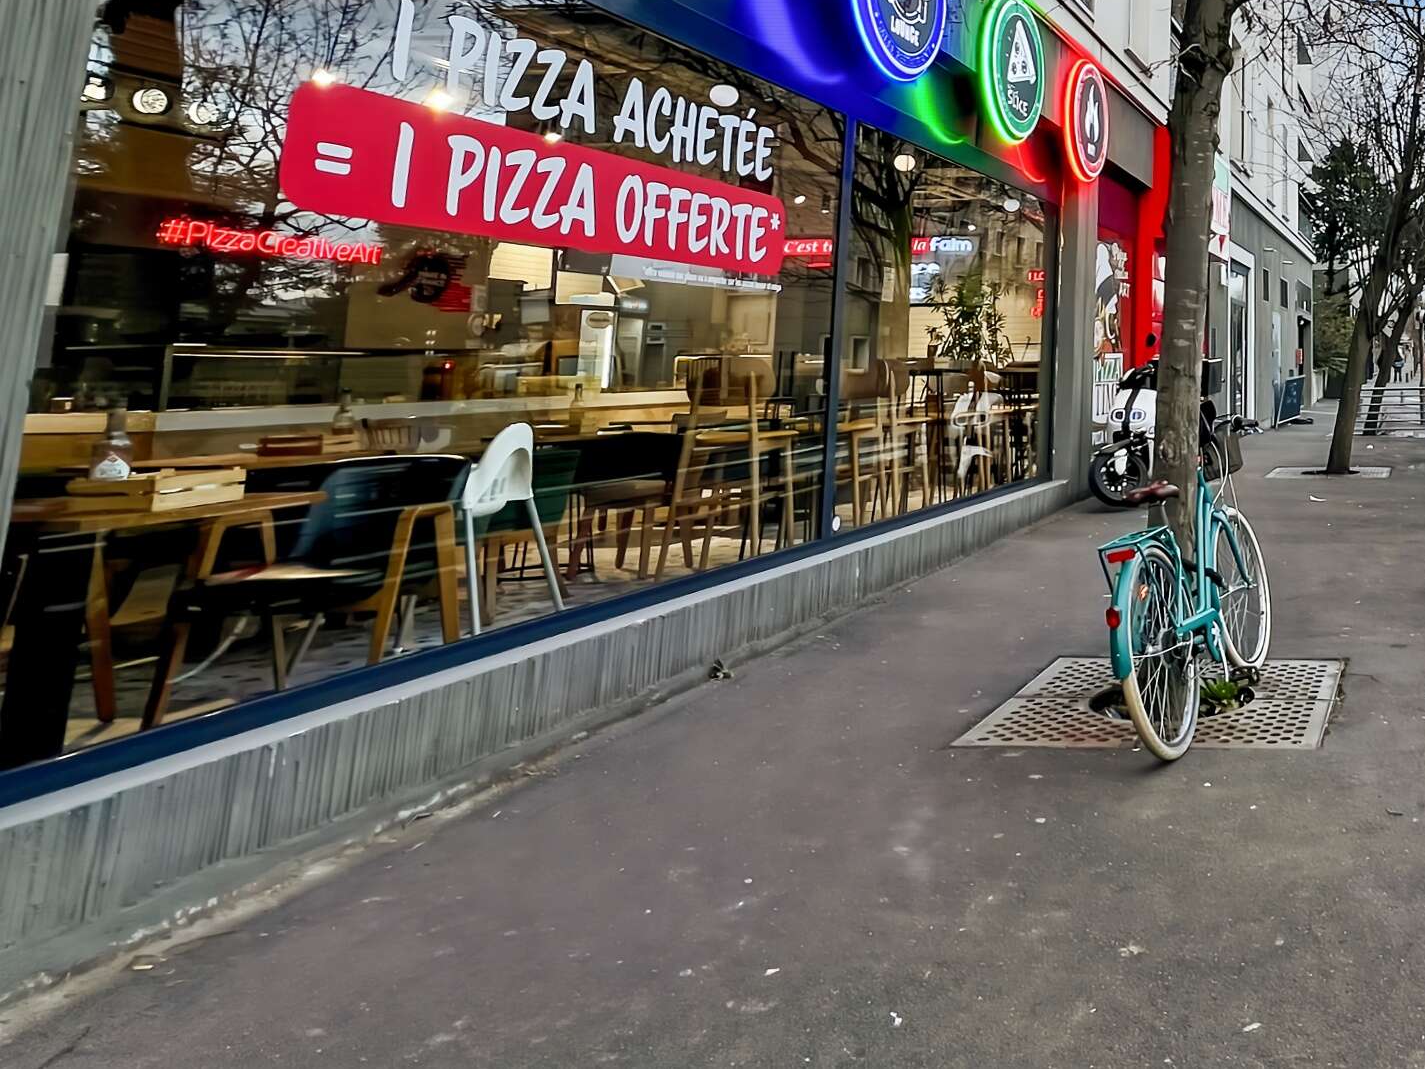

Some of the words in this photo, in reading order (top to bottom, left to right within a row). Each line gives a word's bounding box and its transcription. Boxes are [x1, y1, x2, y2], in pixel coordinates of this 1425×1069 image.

[445, 15, 597, 135] PIZZA
[613, 77, 776, 182] ACHETÉE
[445, 134, 597, 238] PIZZA
